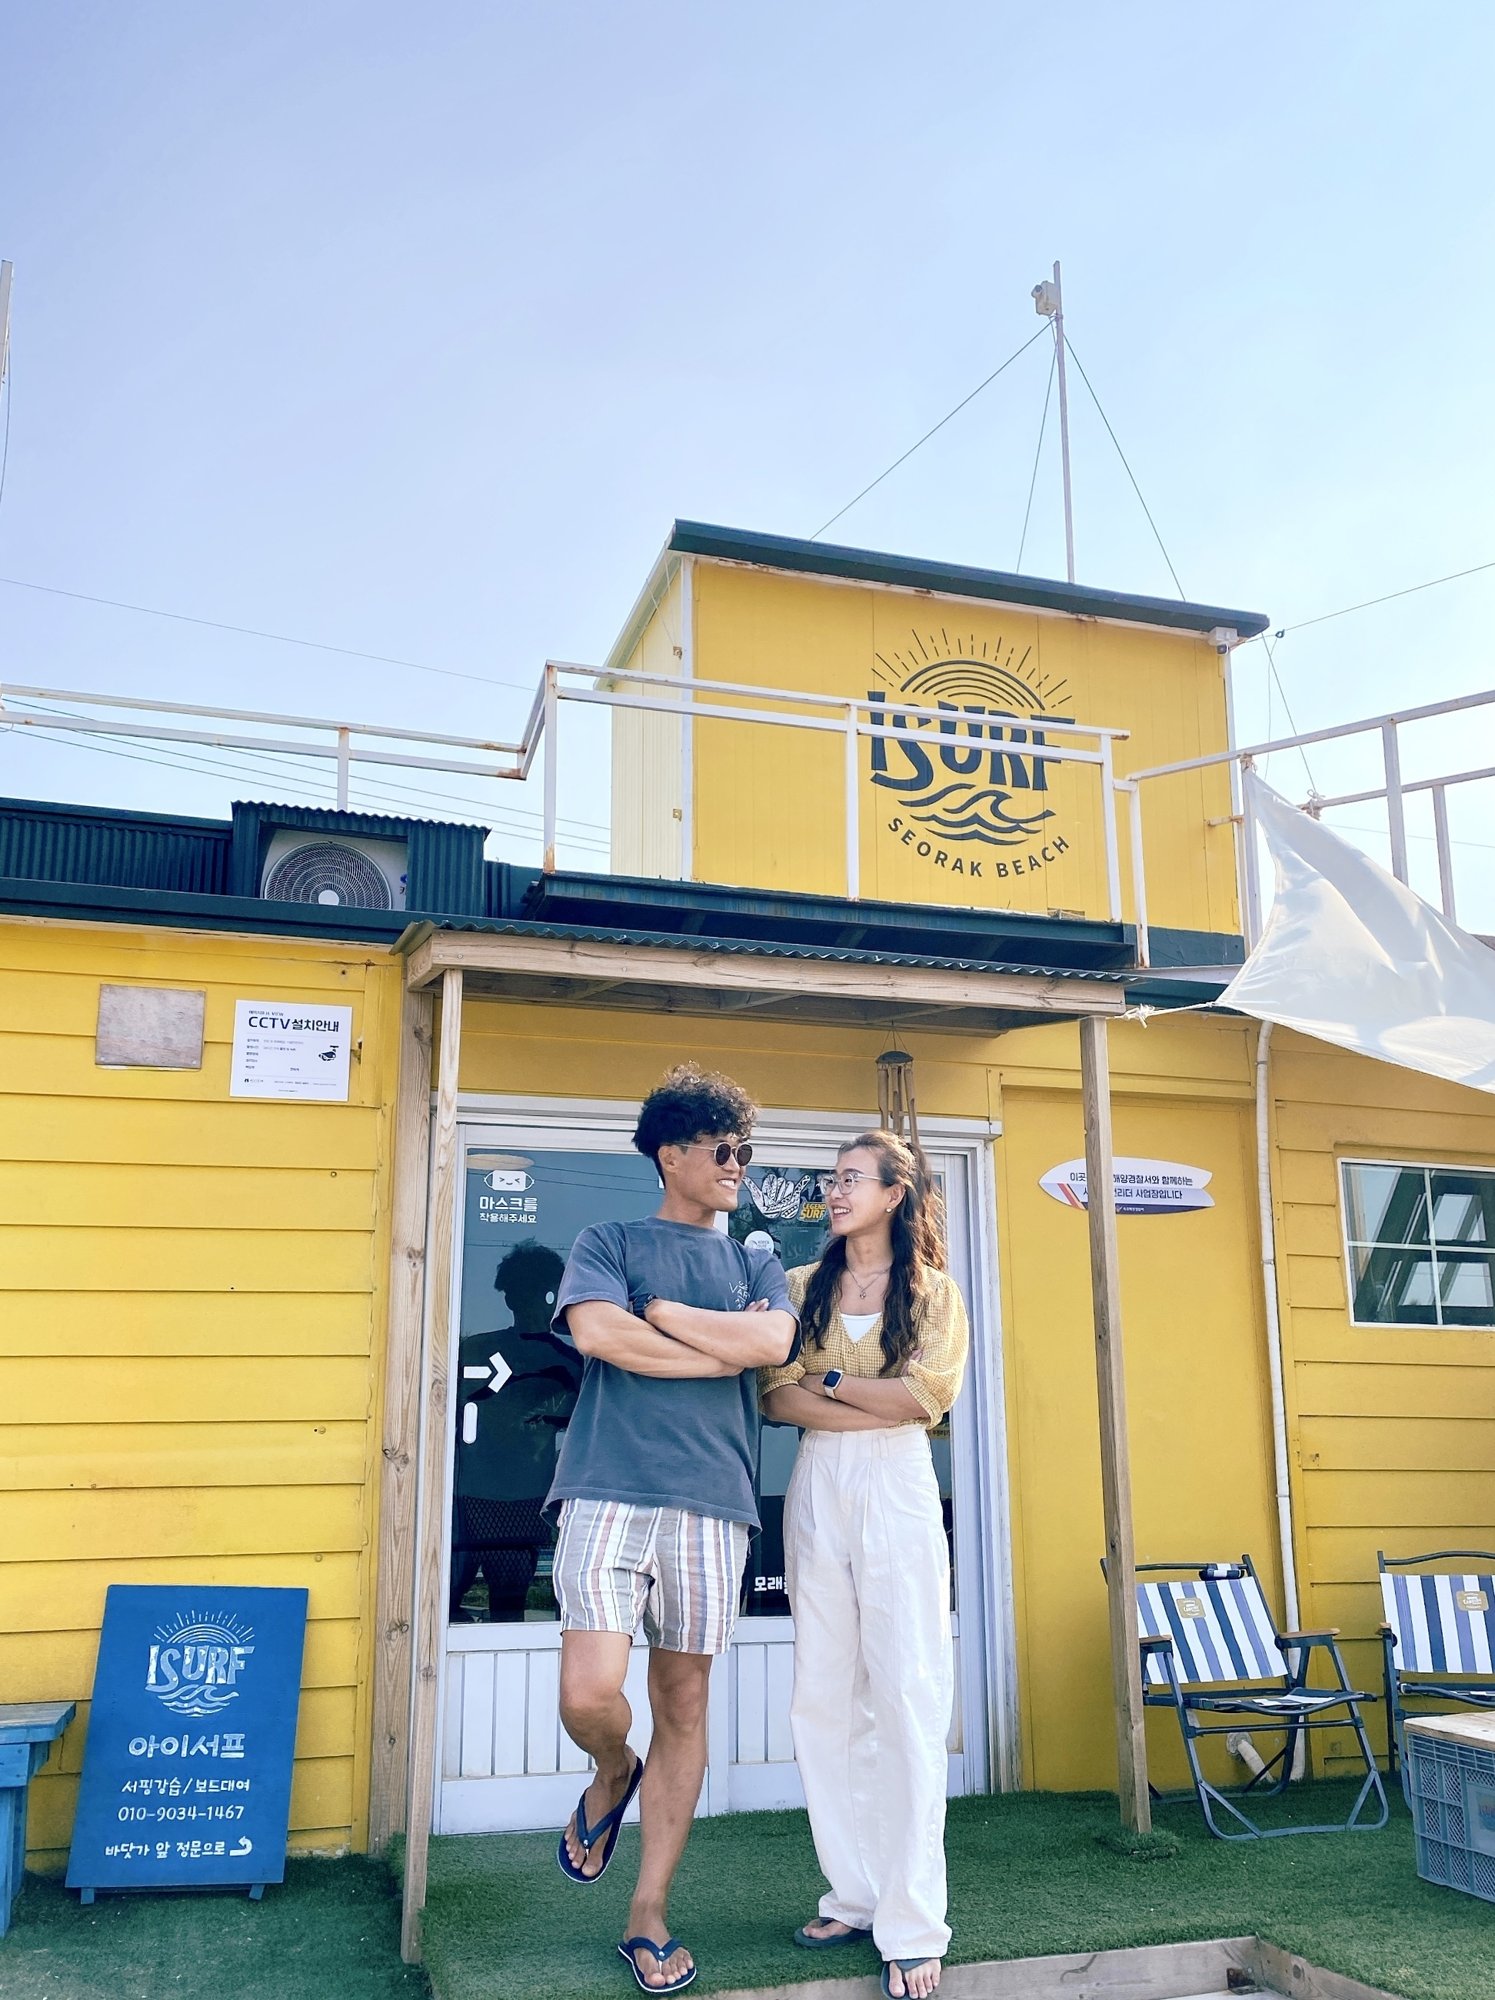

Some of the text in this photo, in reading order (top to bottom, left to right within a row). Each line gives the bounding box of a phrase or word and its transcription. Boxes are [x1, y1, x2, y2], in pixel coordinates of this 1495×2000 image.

[867, 690, 1076, 791] ISURF
[887, 817, 1070, 878] SEORAK BEACH
[248, 1016, 340, 1033] CCTV설치안내
[1069, 1172, 1194, 1187] 이곳 해양경찰서와 함께하는
[1114, 1187, 1183, 1200] 리더 사업장입니다
[479, 1196, 538, 1213] 마스크를
[479, 1212, 538, 1224] 착용해주세요
[799, 1208, 826, 1219] SURF
[144, 1644, 255, 1692] ISURF
[128, 1733, 246, 1759] 아이서프
[117, 1805, 245, 1822] 010-9034-1467
[104, 1840, 226, 1859] 바닷가 앞 정문으로
